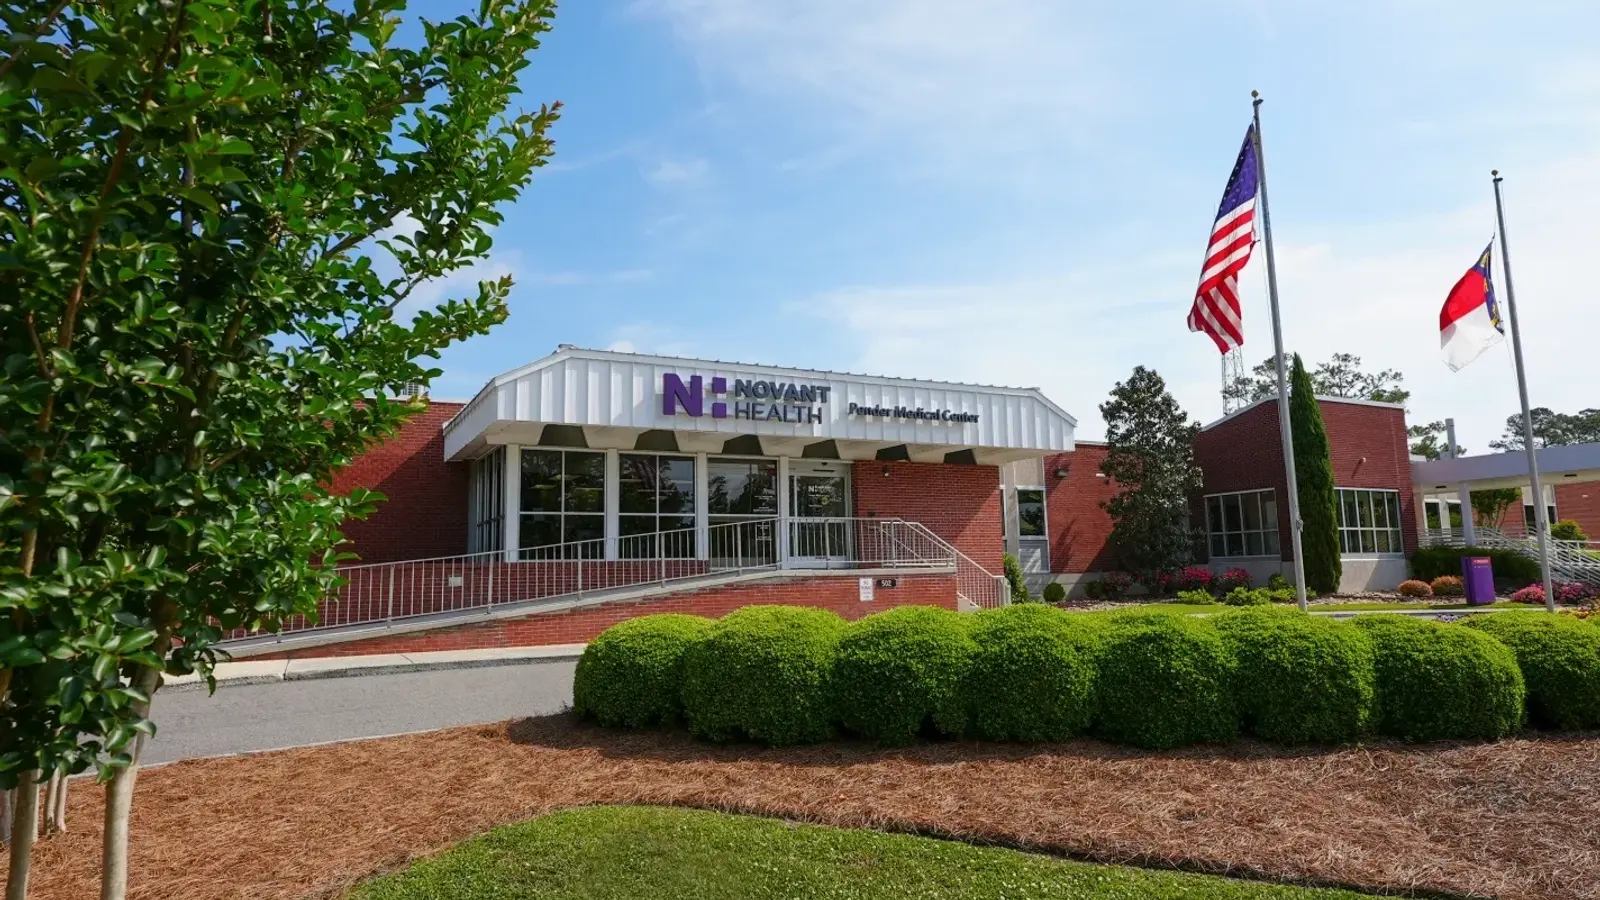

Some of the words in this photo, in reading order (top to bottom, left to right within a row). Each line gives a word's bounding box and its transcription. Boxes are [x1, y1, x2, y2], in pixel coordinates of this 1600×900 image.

[735, 379, 831, 404] NOVANT
[735, 402, 823, 425] HEALTH
[848, 402, 892, 418] Pender
[893, 405, 939, 421] Medical
[942, 409, 980, 424] Center
[881, 579, 892, 587] 502
